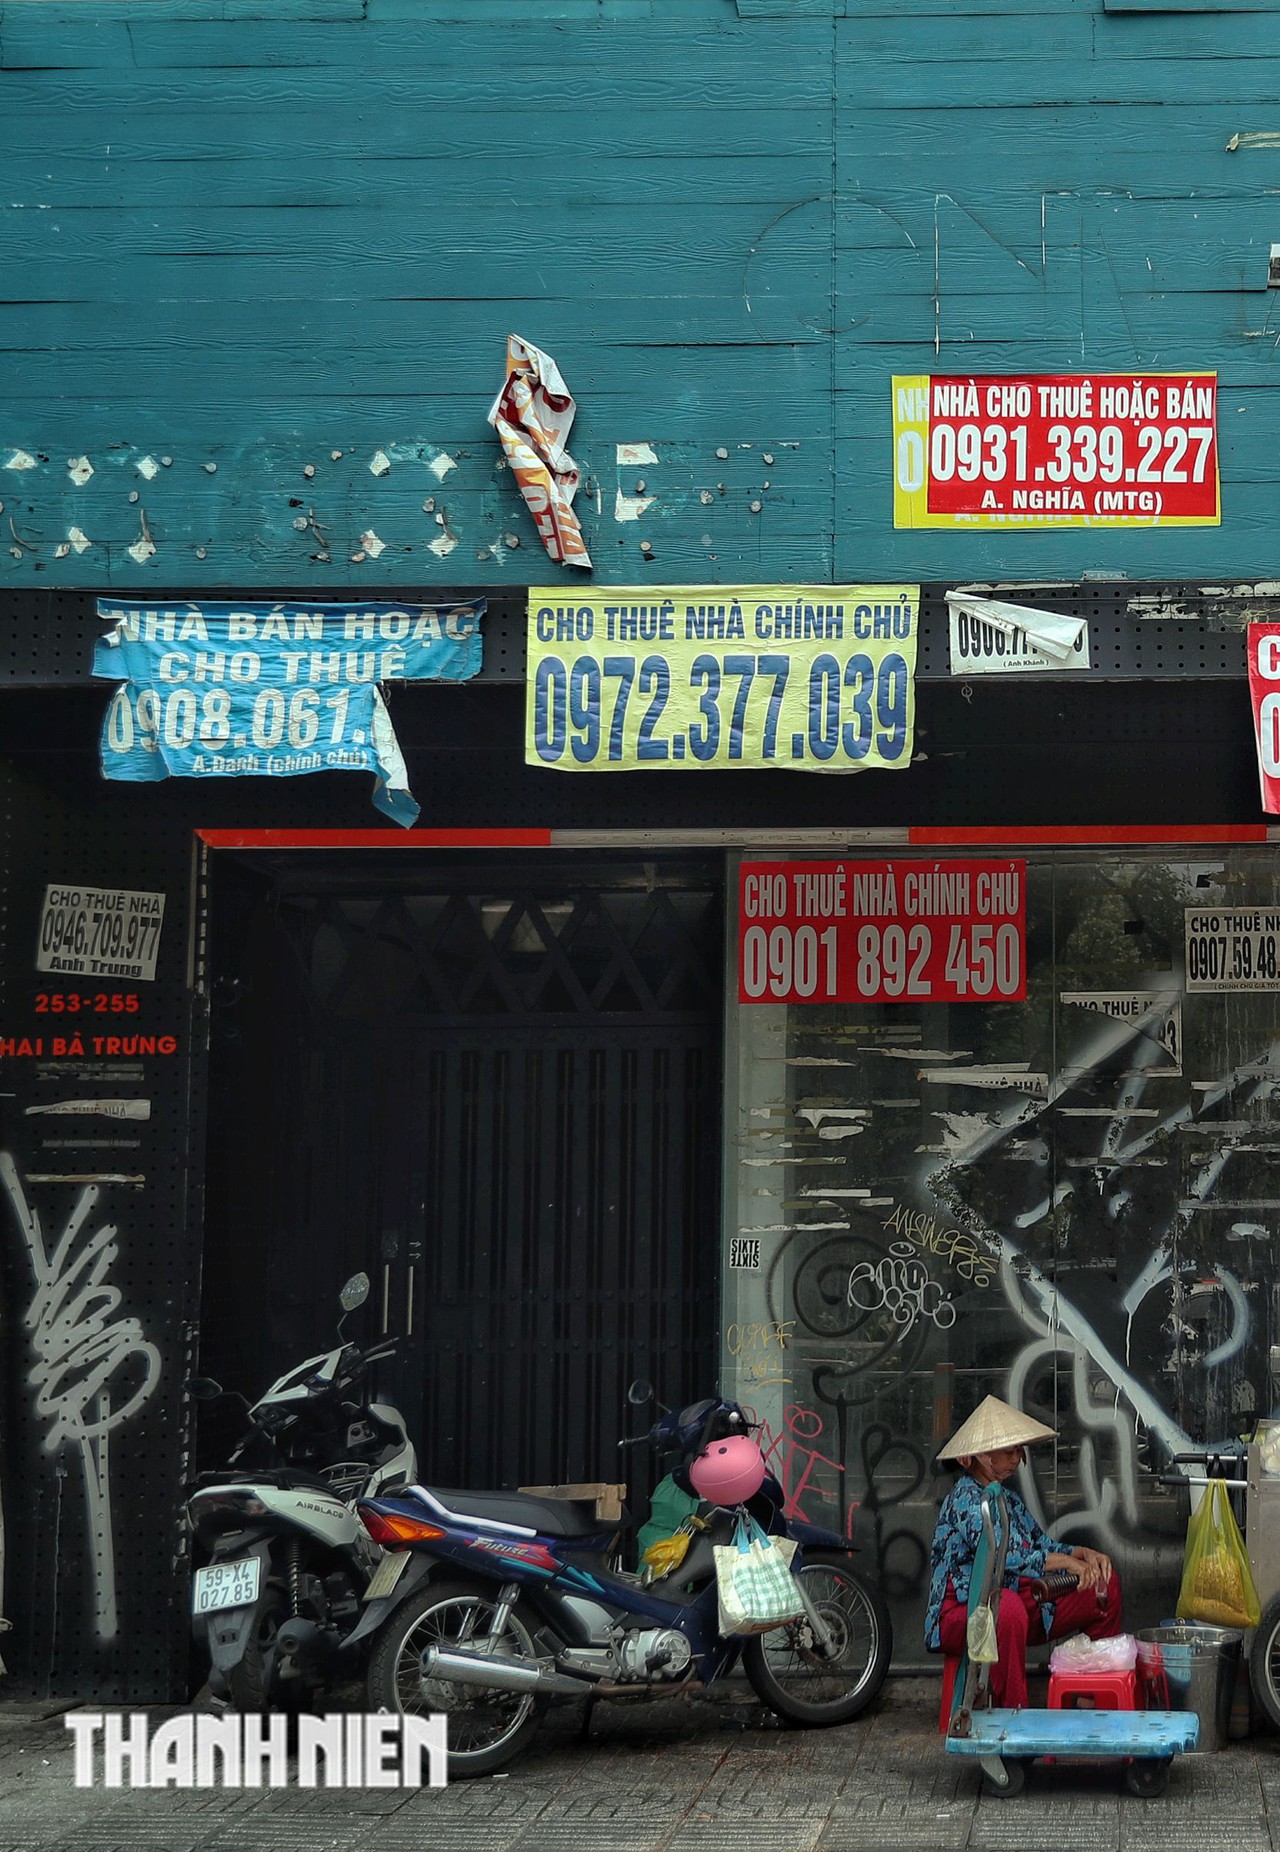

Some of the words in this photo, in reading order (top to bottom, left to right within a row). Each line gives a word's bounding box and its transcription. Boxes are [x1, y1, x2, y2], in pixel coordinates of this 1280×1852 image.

[933, 380, 979, 417] NHÀ
[986, 385, 1031, 417] CHO
[1038, 381, 1092, 417] THUÊ
[1100, 381, 1159, 425] HOẶC
[1169, 381, 1212, 420] BÁN
[931, 423, 1213, 483] 0931.339.227
[981, 490, 1003, 510] A.
[1012, 486, 1085, 510] NGHĨA
[1094, 490, 1163, 515] (MTG)
[228, 604, 324, 641] BÁN
[536, 607, 594, 642] CHO
[603, 600, 675, 641] THUÊ
[685, 598, 745, 640] NHÀ
[755, 597, 843, 640] CHÍNH
[854, 593, 911, 639] CHỦ
[159, 652, 261, 684] CHO
[280, 643, 406, 684] THUÊ
[534, 653, 908, 763] 0972.377.039
[192, 755, 259, 772] A.Danh
[267, 753, 322, 775] (chính
[326, 747, 367, 768] chủ)
[50, 890, 80, 907] CHO
[86, 893, 125, 912] THUÊ
[129, 895, 161, 915] NHÀ
[744, 874, 787, 918] CHO
[793, 865, 846, 917] THUÊ
[853, 864, 898, 916] NHÀ
[904, 864, 969, 916] CHÍNH
[976, 863, 1019, 916] CHỦ
[42, 908, 161, 961] 0946.709.977
[1191, 917, 1220, 932] CHO
[1224, 911, 1260, 932] THUÊ
[50, 956, 84, 972] Anh
[90, 958, 143, 978] Trung
[743, 925, 837, 997] 0901
[857, 924, 932, 997] 892
[945, 923, 1020, 996] 450
[35, 994, 140, 1012] 253-255
[1102, 997, 1139, 1016] THUÊ
[0, 1038, 42, 1056] HAI
[93, 1034, 177, 1055] TRƯNG
[731, 1239, 760, 1253] SIXTE
[206, 1563, 249, 1588] 59-X4
[201, 1581, 253, 1609] 027.85
